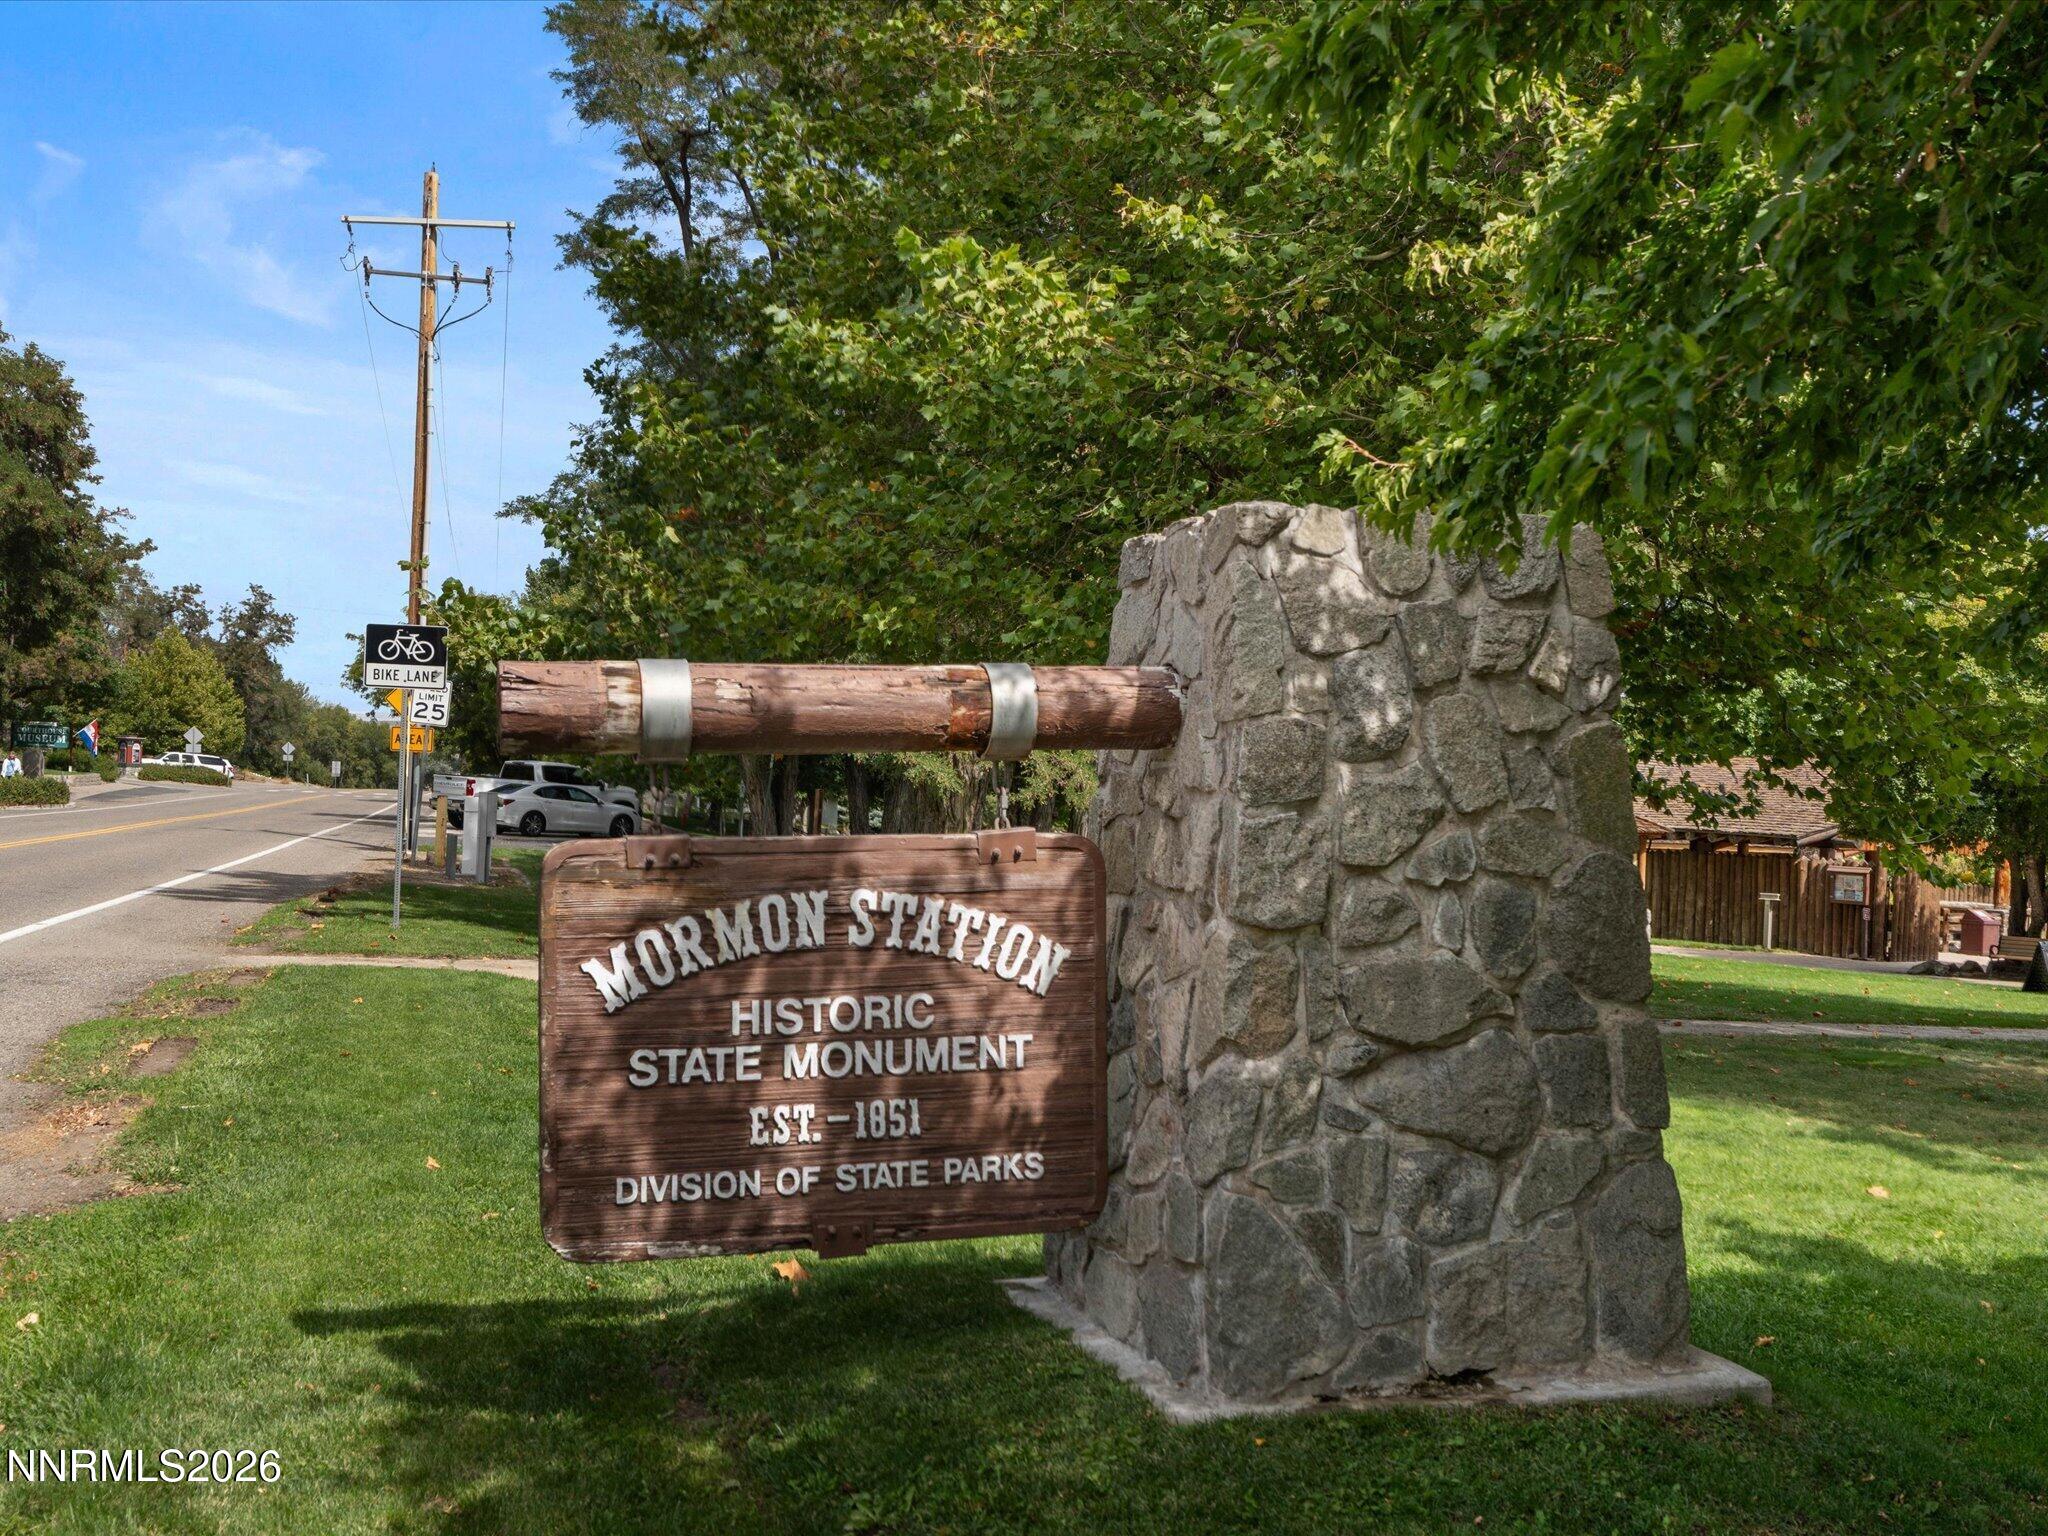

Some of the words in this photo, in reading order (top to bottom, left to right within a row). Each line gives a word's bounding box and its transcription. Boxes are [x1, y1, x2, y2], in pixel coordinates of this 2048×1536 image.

[373, 668, 400, 681] BIKE
[407, 670, 437, 683] LANE
[413, 702, 445, 721] 25
[418, 693, 443, 702] LIMIT
[17, 734, 66, 744] MUSEUM
[581, 889, 829, 1013] MORMON
[847, 888, 1070, 998] STATION
[731, 992, 935, 1037] HISTORIC
[628, 1046, 762, 1088] STATE
[783, 1034, 1034, 1080] MONUMENT
[615, 1169, 761, 1205] DIVISION
[775, 1165, 820, 1196] OF
[835, 1158, 929, 1194] STATE
[943, 1152, 1045, 1185] PARKS
